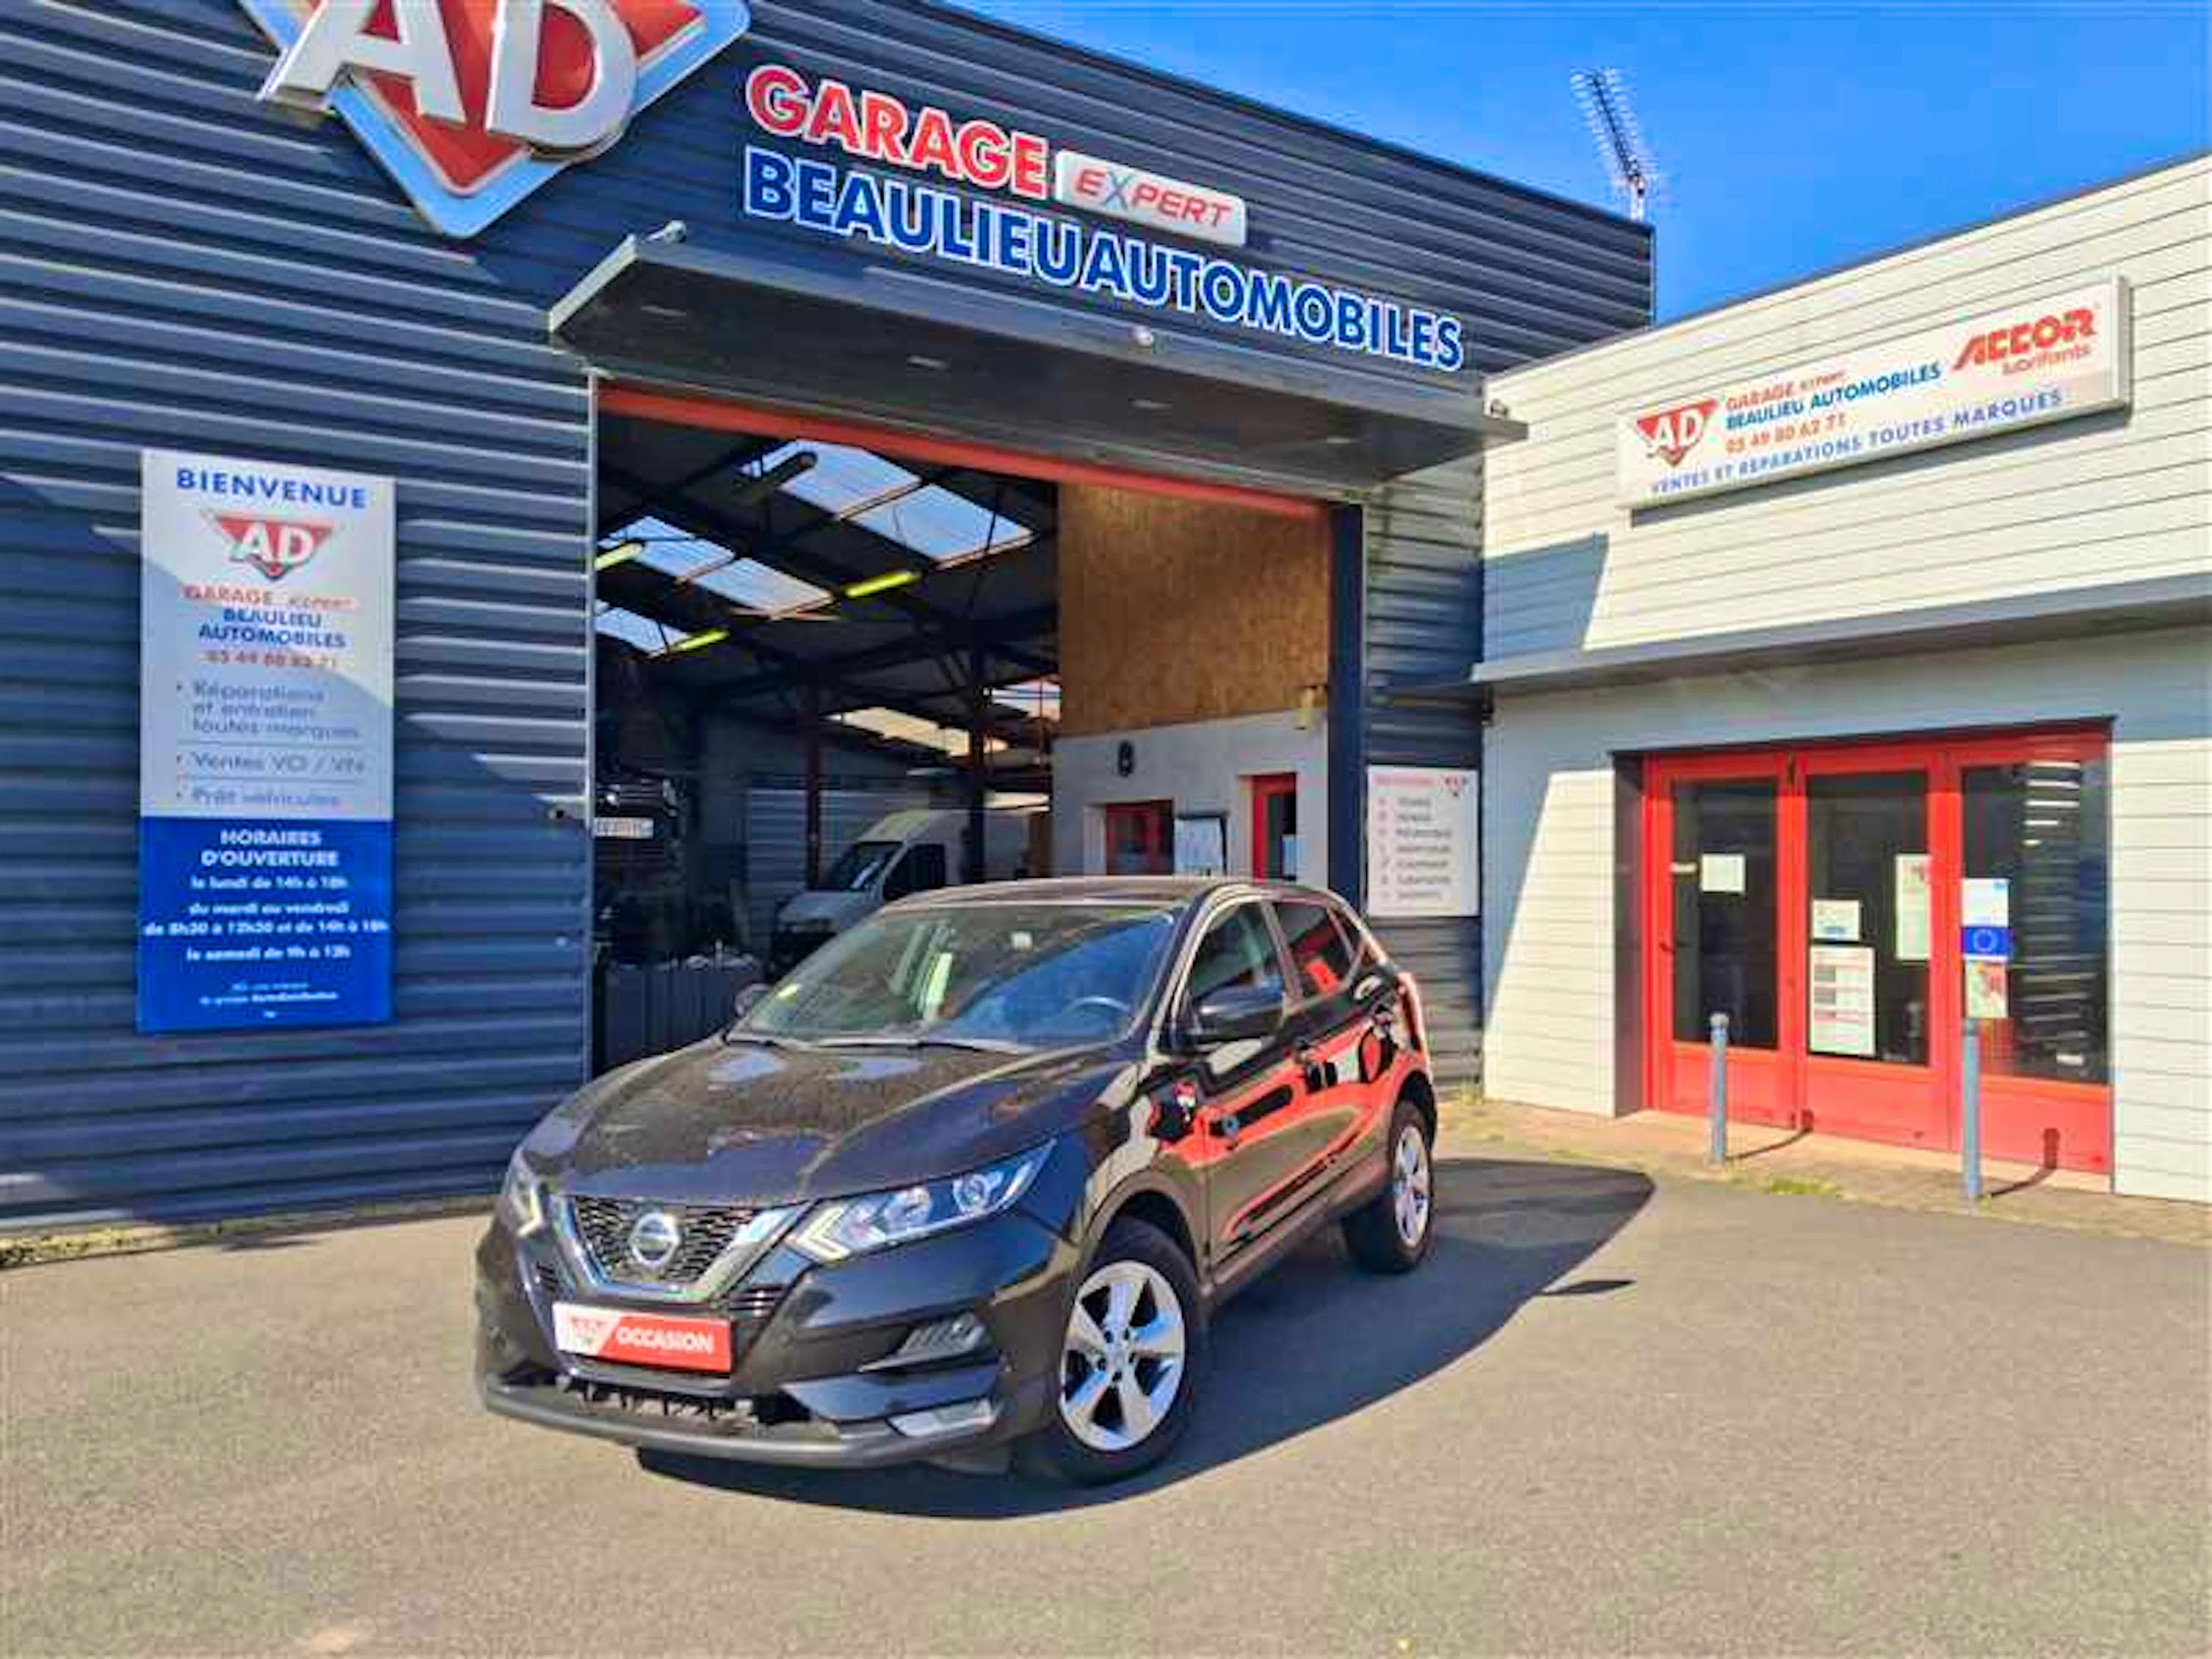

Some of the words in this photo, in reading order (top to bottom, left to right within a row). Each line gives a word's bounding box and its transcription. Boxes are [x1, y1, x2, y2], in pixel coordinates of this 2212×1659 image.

[255, 0, 638, 153] AD
[746, 65, 1048, 200] GARAGE
[1726, 400, 1804, 430] BEAULIEU
[1811, 361, 1942, 408] AUTOMOBILES
[1726, 382, 1794, 411] GARAGE
[1646, 408, 1703, 458] AD
[1650, 468, 1710, 492] VENTES
[1714, 464, 1733, 480] ET
[1869, 417, 1944, 447] TOUTES
[1955, 389, 2062, 425] MARQUES
[177, 469, 366, 508] BIENVENUE
[232, 520, 315, 564] AD
[183, 584, 272, 605] GARAGE
[224, 608, 321, 627] BEAULIEU
[199, 624, 346, 647] AUTOMOBILES
[220, 830, 323, 846] HORAIRES
[200, 850, 340, 866] D'OUVERTURE
[616, 1326, 714, 1354] OCCASION
